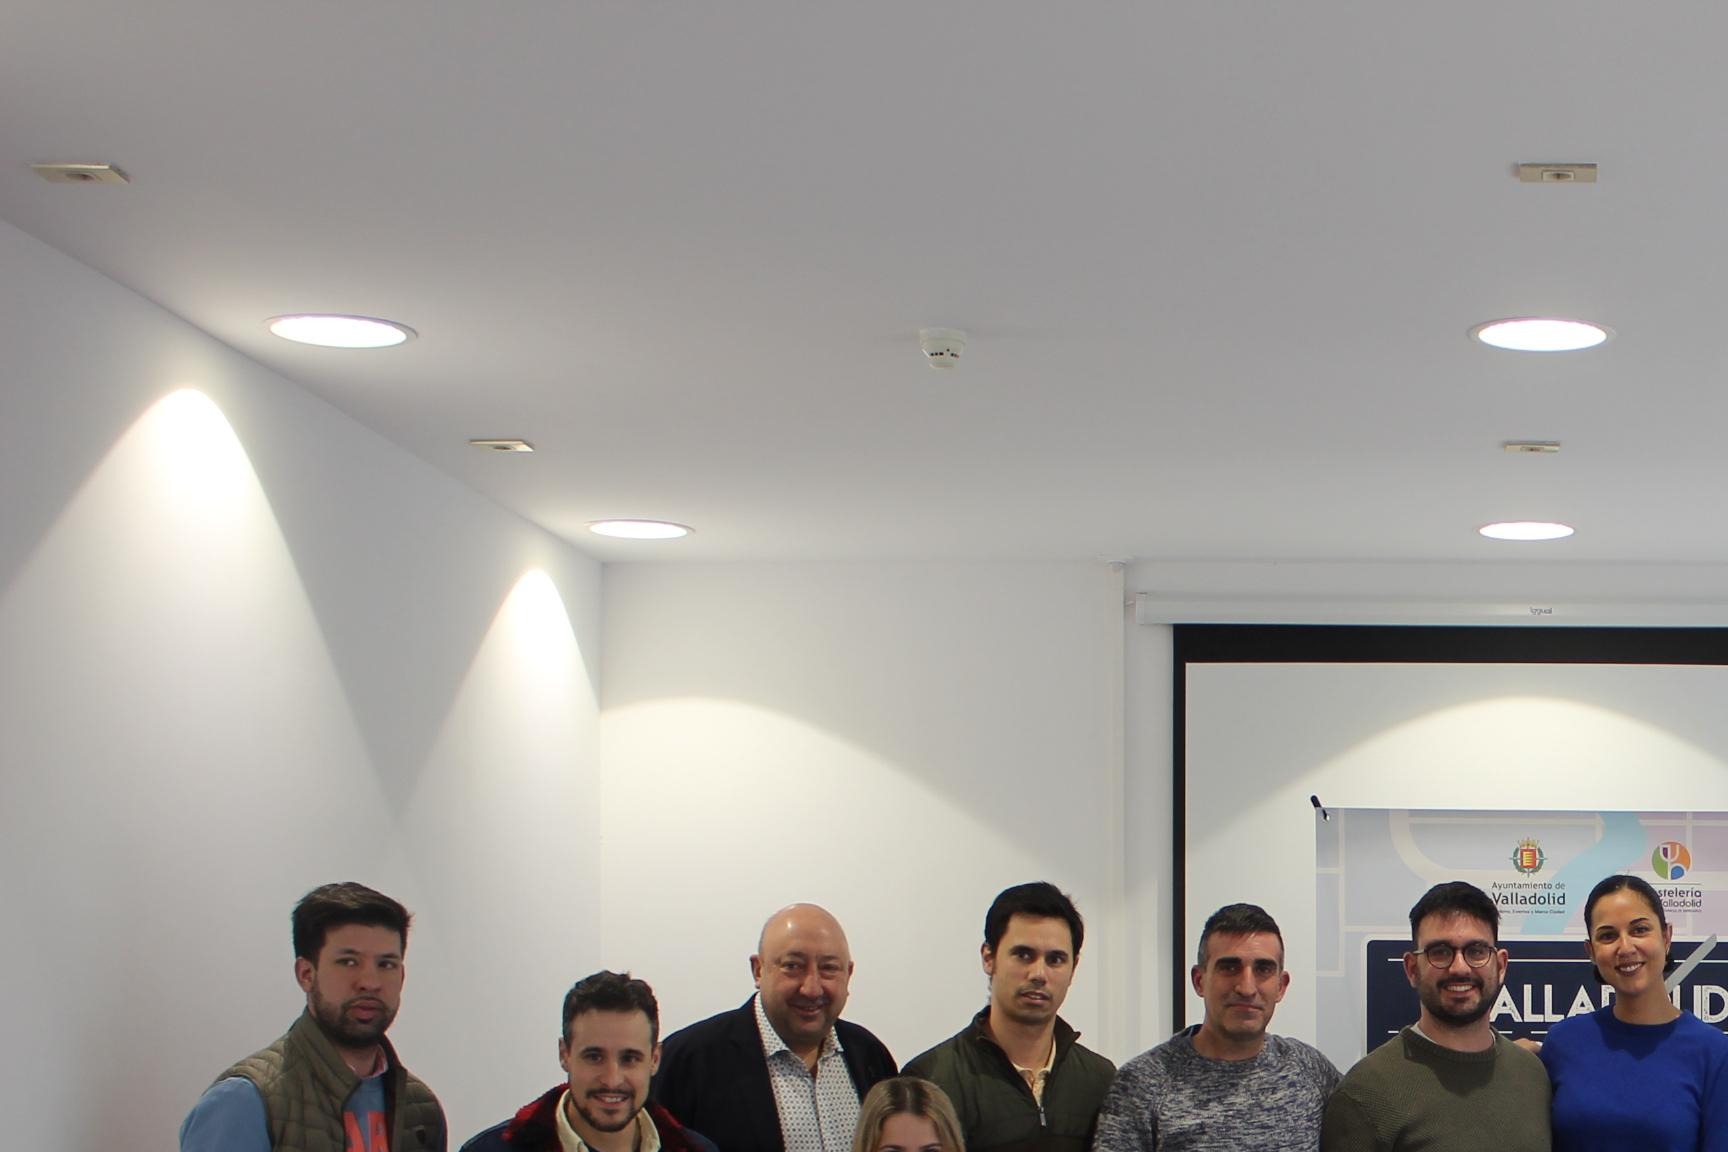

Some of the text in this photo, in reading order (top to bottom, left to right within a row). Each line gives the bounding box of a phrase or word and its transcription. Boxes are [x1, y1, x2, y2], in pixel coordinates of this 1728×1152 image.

[1491, 881, 1566, 893] Ayuntamiento de
[1491, 892, 1566, 905] Valladolid
[1660, 898, 1702, 907] alladolid
